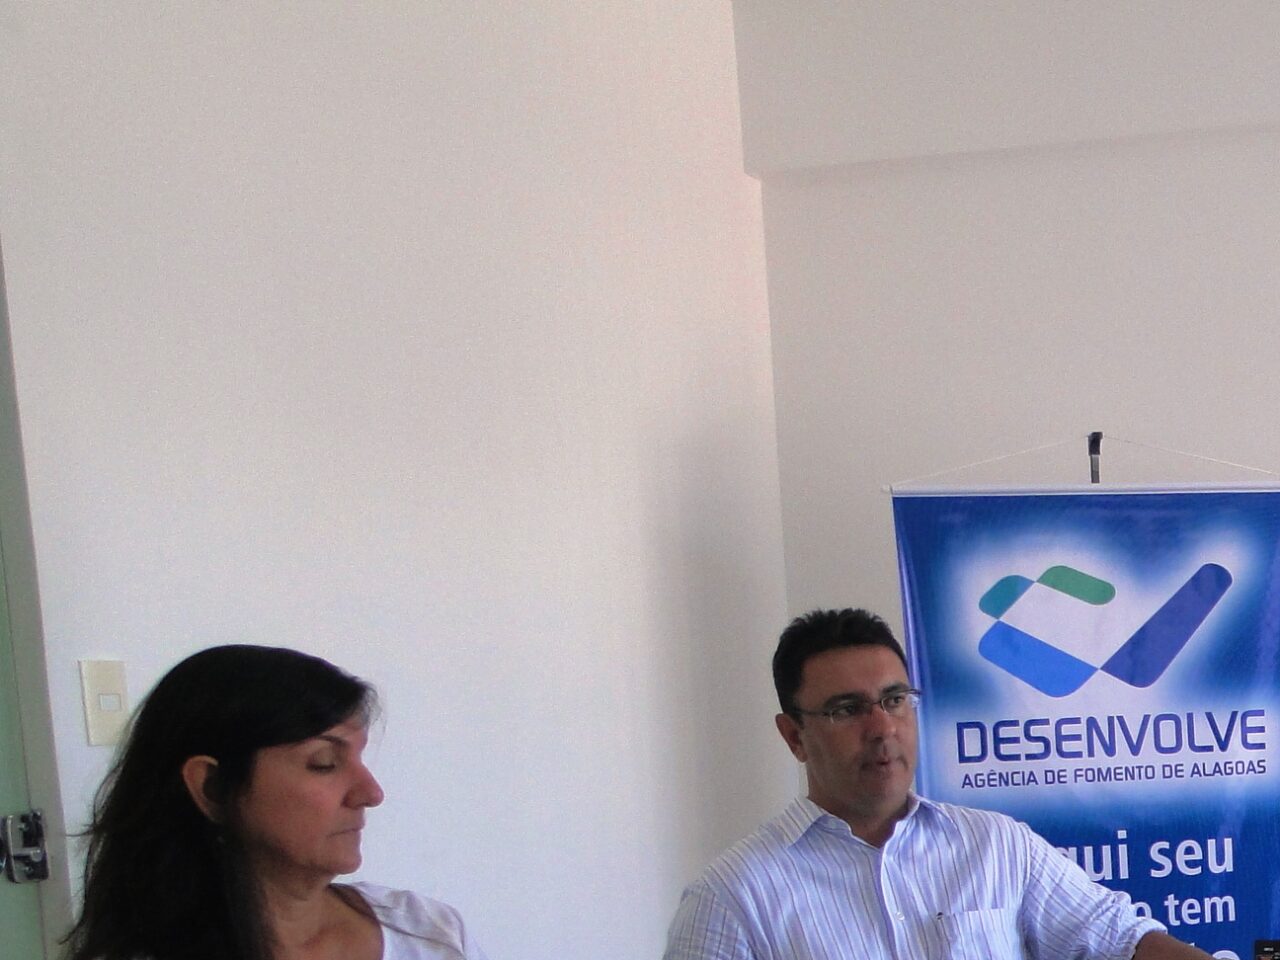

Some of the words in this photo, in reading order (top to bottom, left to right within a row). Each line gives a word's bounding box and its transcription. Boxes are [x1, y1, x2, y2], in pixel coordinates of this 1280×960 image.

[956, 709, 1267, 764] DESENVOLVE
[961, 769, 1039, 789] AGÊNCIA
[1044, 768, 1068, 785] DE
[1074, 764, 1156, 783] FOMENTO
[1162, 763, 1185, 779] DE
[1190, 759, 1267, 778] ALAGOAS
[1055, 830, 1130, 881] ui
[1150, 837, 1234, 878] seu
[1163, 893, 1236, 927] tem
